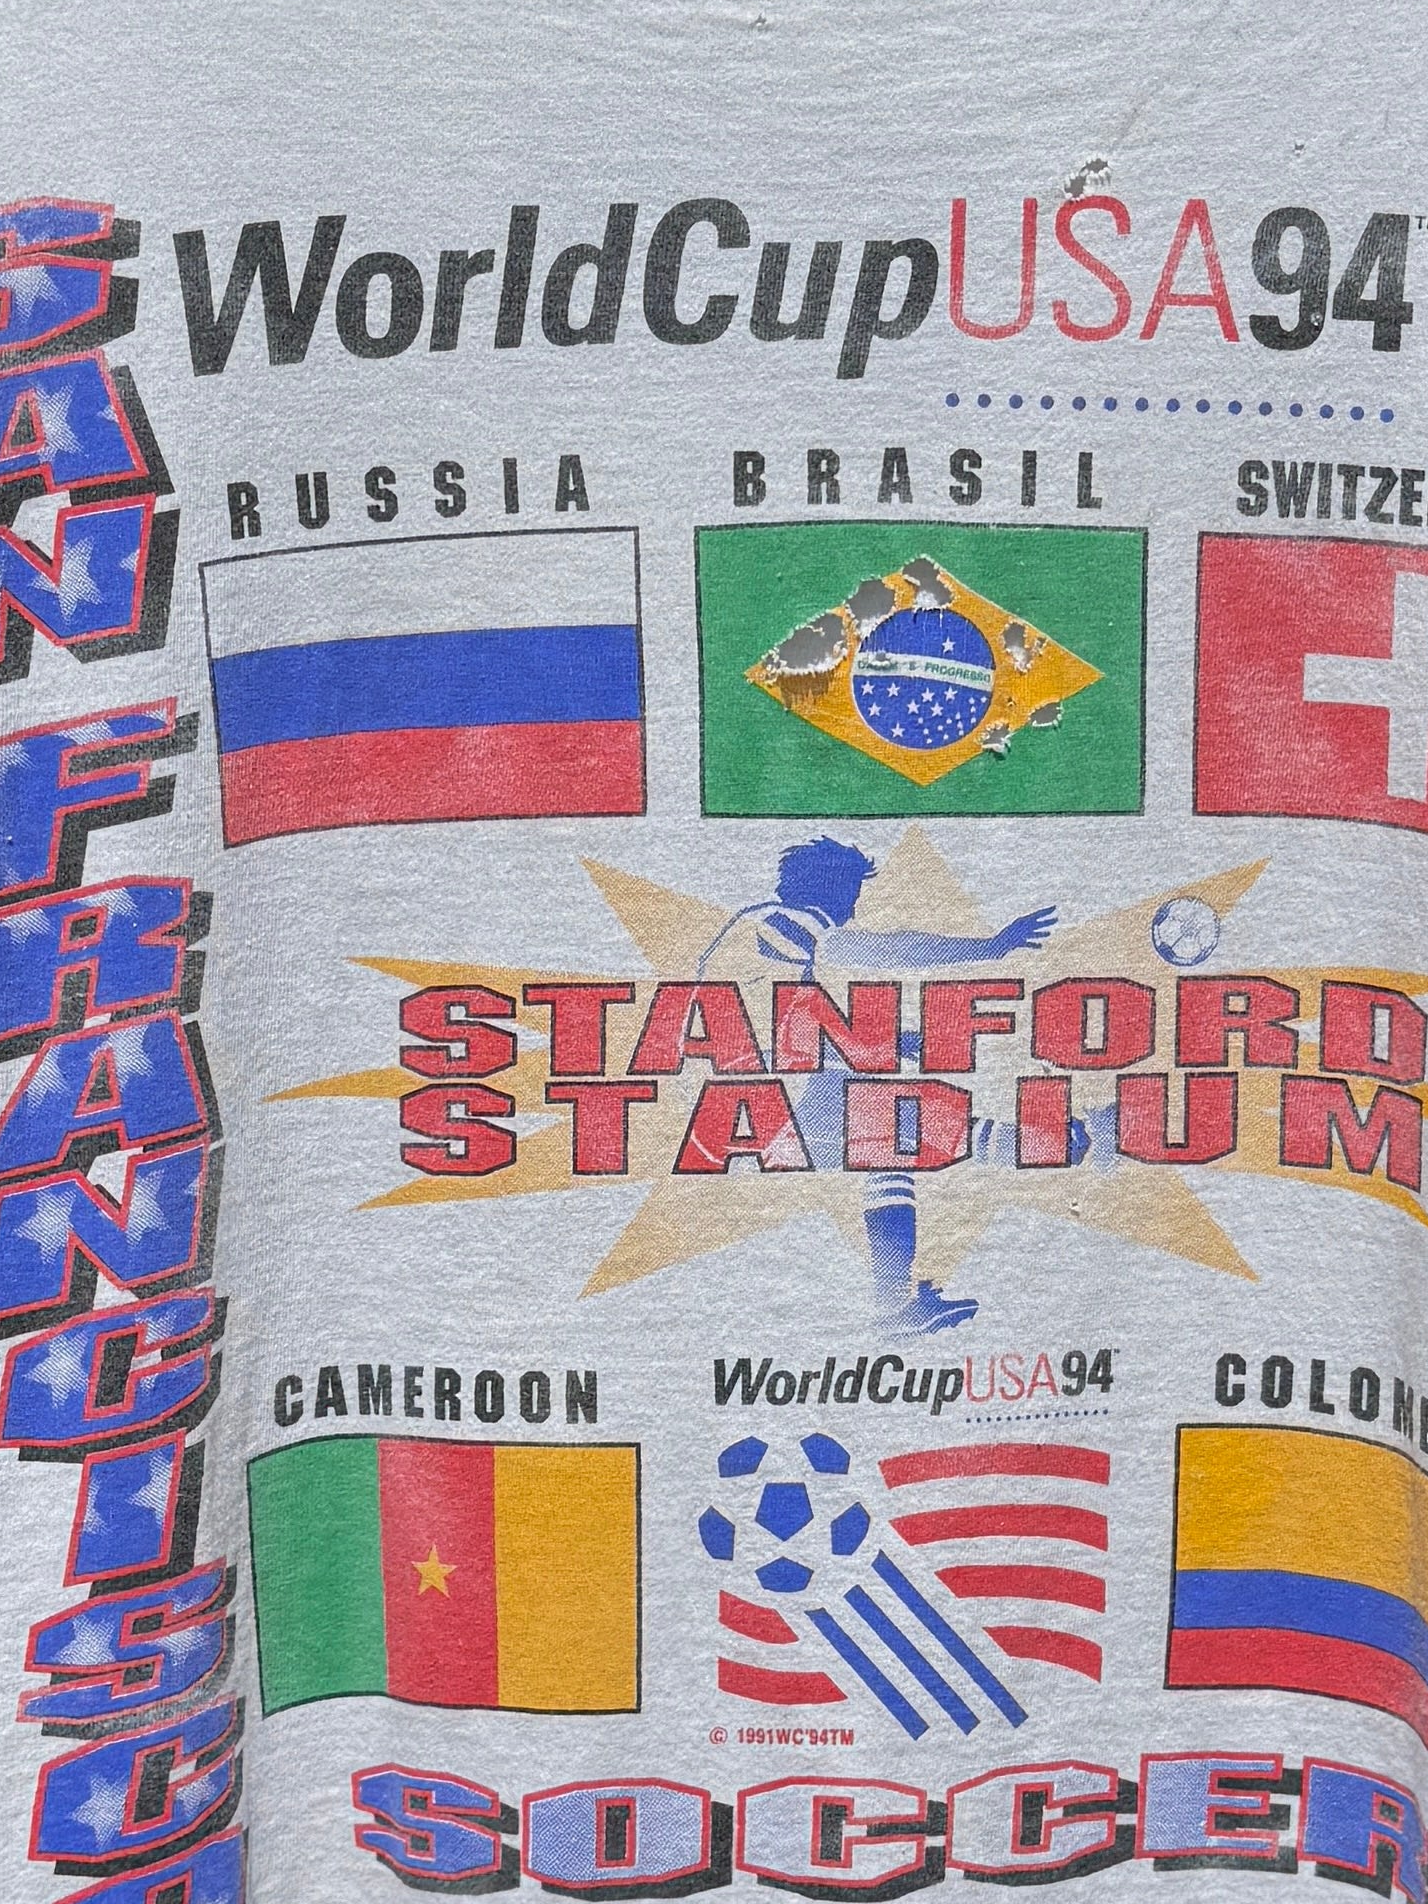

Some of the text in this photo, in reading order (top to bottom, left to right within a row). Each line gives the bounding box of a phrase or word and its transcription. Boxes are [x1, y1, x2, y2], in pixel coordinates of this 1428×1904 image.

[227, 454, 590, 541] RUSSIA
[733, 447, 1103, 509] BRASIL
[398, 976, 1428, 1084] STANFORD
[398, 1071, 1423, 1194] STADIUM
[274, 1364, 599, 1425] CAMEROON
